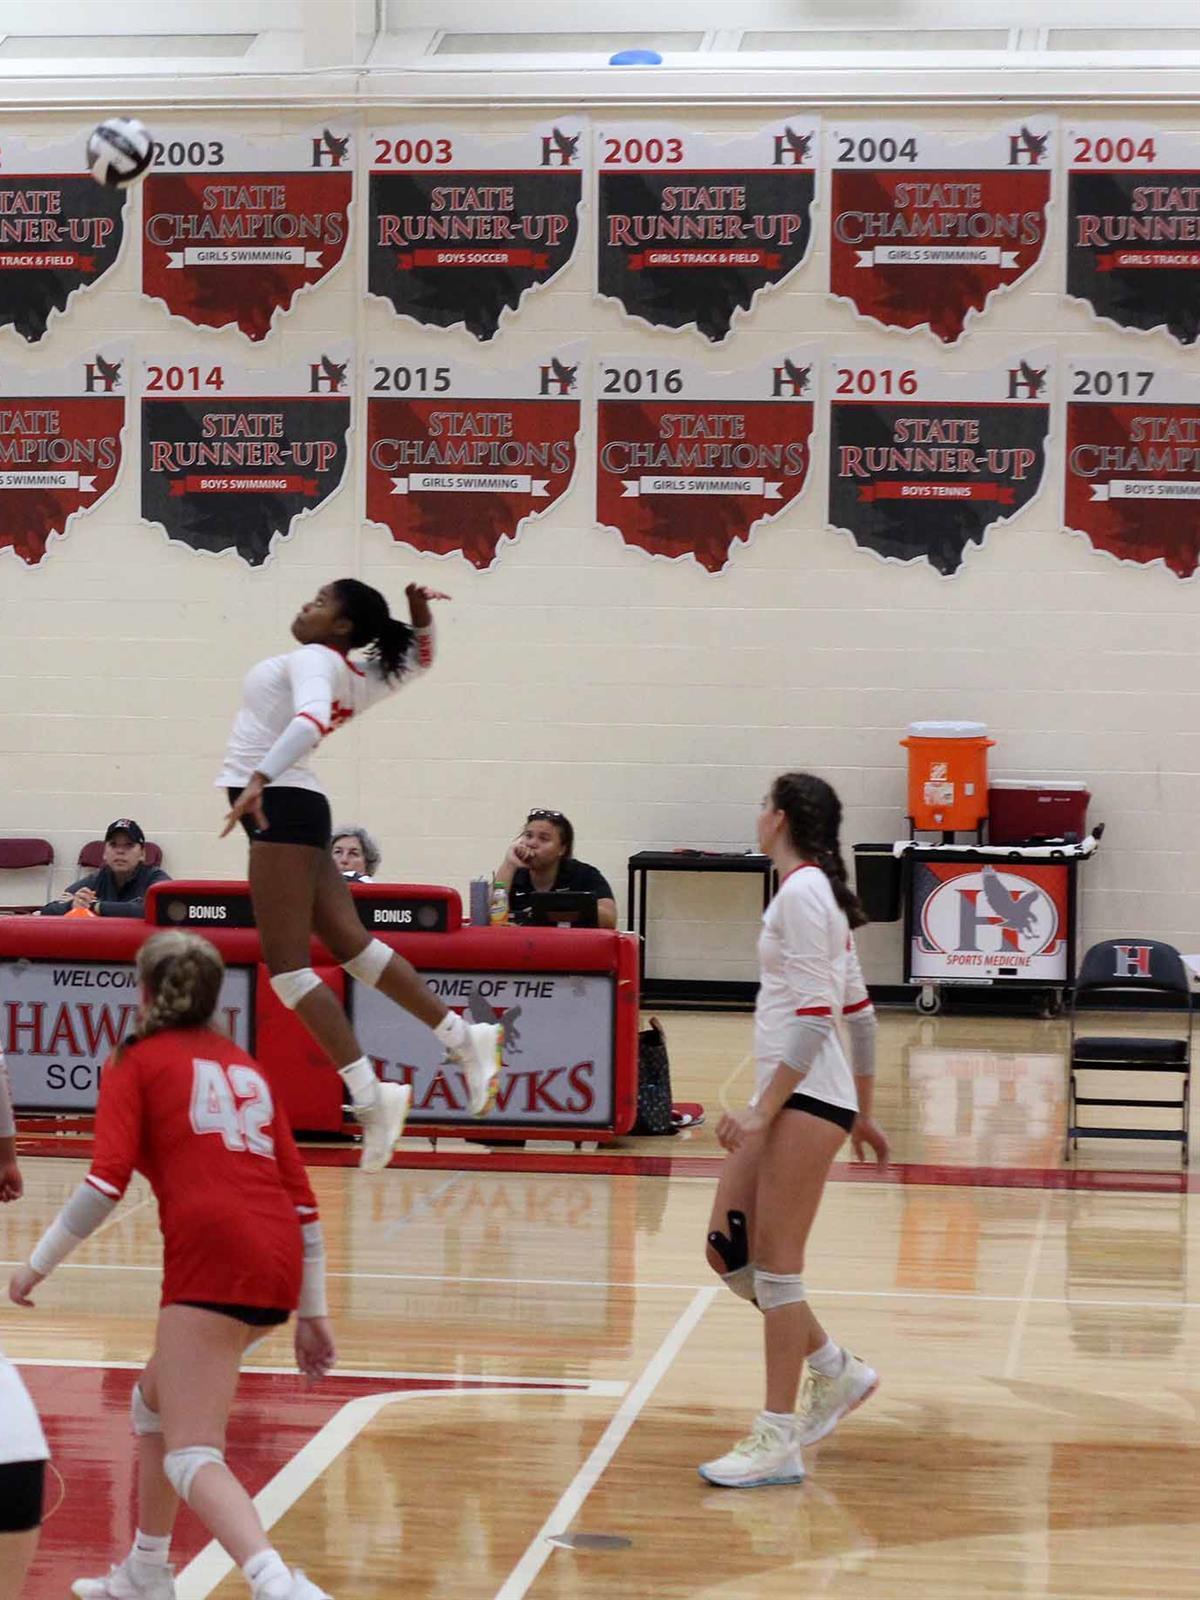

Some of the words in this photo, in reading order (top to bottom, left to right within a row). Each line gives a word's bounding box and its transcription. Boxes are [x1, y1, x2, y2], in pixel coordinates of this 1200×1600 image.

[151, 142, 224, 166] 2003
[375, 140, 452, 163] 2003
[604, 139, 684, 162] 2003
[837, 138, 918, 162] 2004
[1073, 138, 1156, 162] 2004
[203, 186, 285, 210] STATE
[431, 188, 513, 211] STATE
[661, 187, 745, 210] STATE
[893, 183, 981, 208] STATE
[146, 214, 342, 245] CHAMPIONS
[378, 216, 568, 247] RUNNER-UP
[608, 215, 800, 246] RUNNER-UP
[834, 213, 1040, 245] CHAMPIONS
[0, 256, 34, 266] TRACK
[36, 256, 43, 266] &
[44, 256, 74, 266] FIELD
[197, 251, 228, 261] GIRLS
[232, 251, 292, 261] SWIMMING
[438, 253, 466, 263] BOYS
[467, 253, 509, 263] SOCCER
[650, 254, 680, 264] GIRLS
[682, 254, 716, 264] TRACK
[719, 254, 728, 264] &
[729, 254, 760, 264] FIELD
[888, 250, 920, 260] GIRLS
[923, 250, 987, 260] SWIMMING
[1120, 254, 1150, 264] GIRLS
[1152, 254, 1190, 264] TRACK
[146, 366, 224, 391] 2014
[374, 367, 451, 391] 2015
[603, 369, 683, 393] 2016
[837, 369, 918, 393] 2016
[1073, 371, 1154, 395] 2017
[202, 415, 283, 437] STATE
[428, 413, 513, 436] STATE
[659, 414, 745, 438] STATE
[893, 420, 979, 444] STATE
[150, 442, 337, 471] RUNNER-UP
[370, 440, 570, 473] CHAMPIONS
[601, 442, 803, 475] CHAMPIONS
[838, 447, 1034, 478] RUNNER-UP
[6, 475, 66, 485] SWIMMING
[200, 480, 228, 489] BOYS
[230, 480, 287, 489] SWIMMING
[422, 478, 454, 488] GIRLS
[456, 478, 518, 488] SWIMMING
[654, 480, 686, 490] GIRLS
[688, 480, 750, 490] SWIMMING
[902, 486, 930, 496] BOYS
[932, 486, 972, 496] TENNIS
[1124, 484, 1154, 495] BOYS
[188, 905, 226, 919] BONUS
[374, 909, 412, 923] BONUS
[946, 954, 982, 966] SPORTS
[984, 955, 1032, 968] MEDICINE
[425, 979, 474, 997] OME
[478, 980, 508, 998] OF
[513, 981, 555, 998] THE
[189, 1058, 276, 1160] 42
